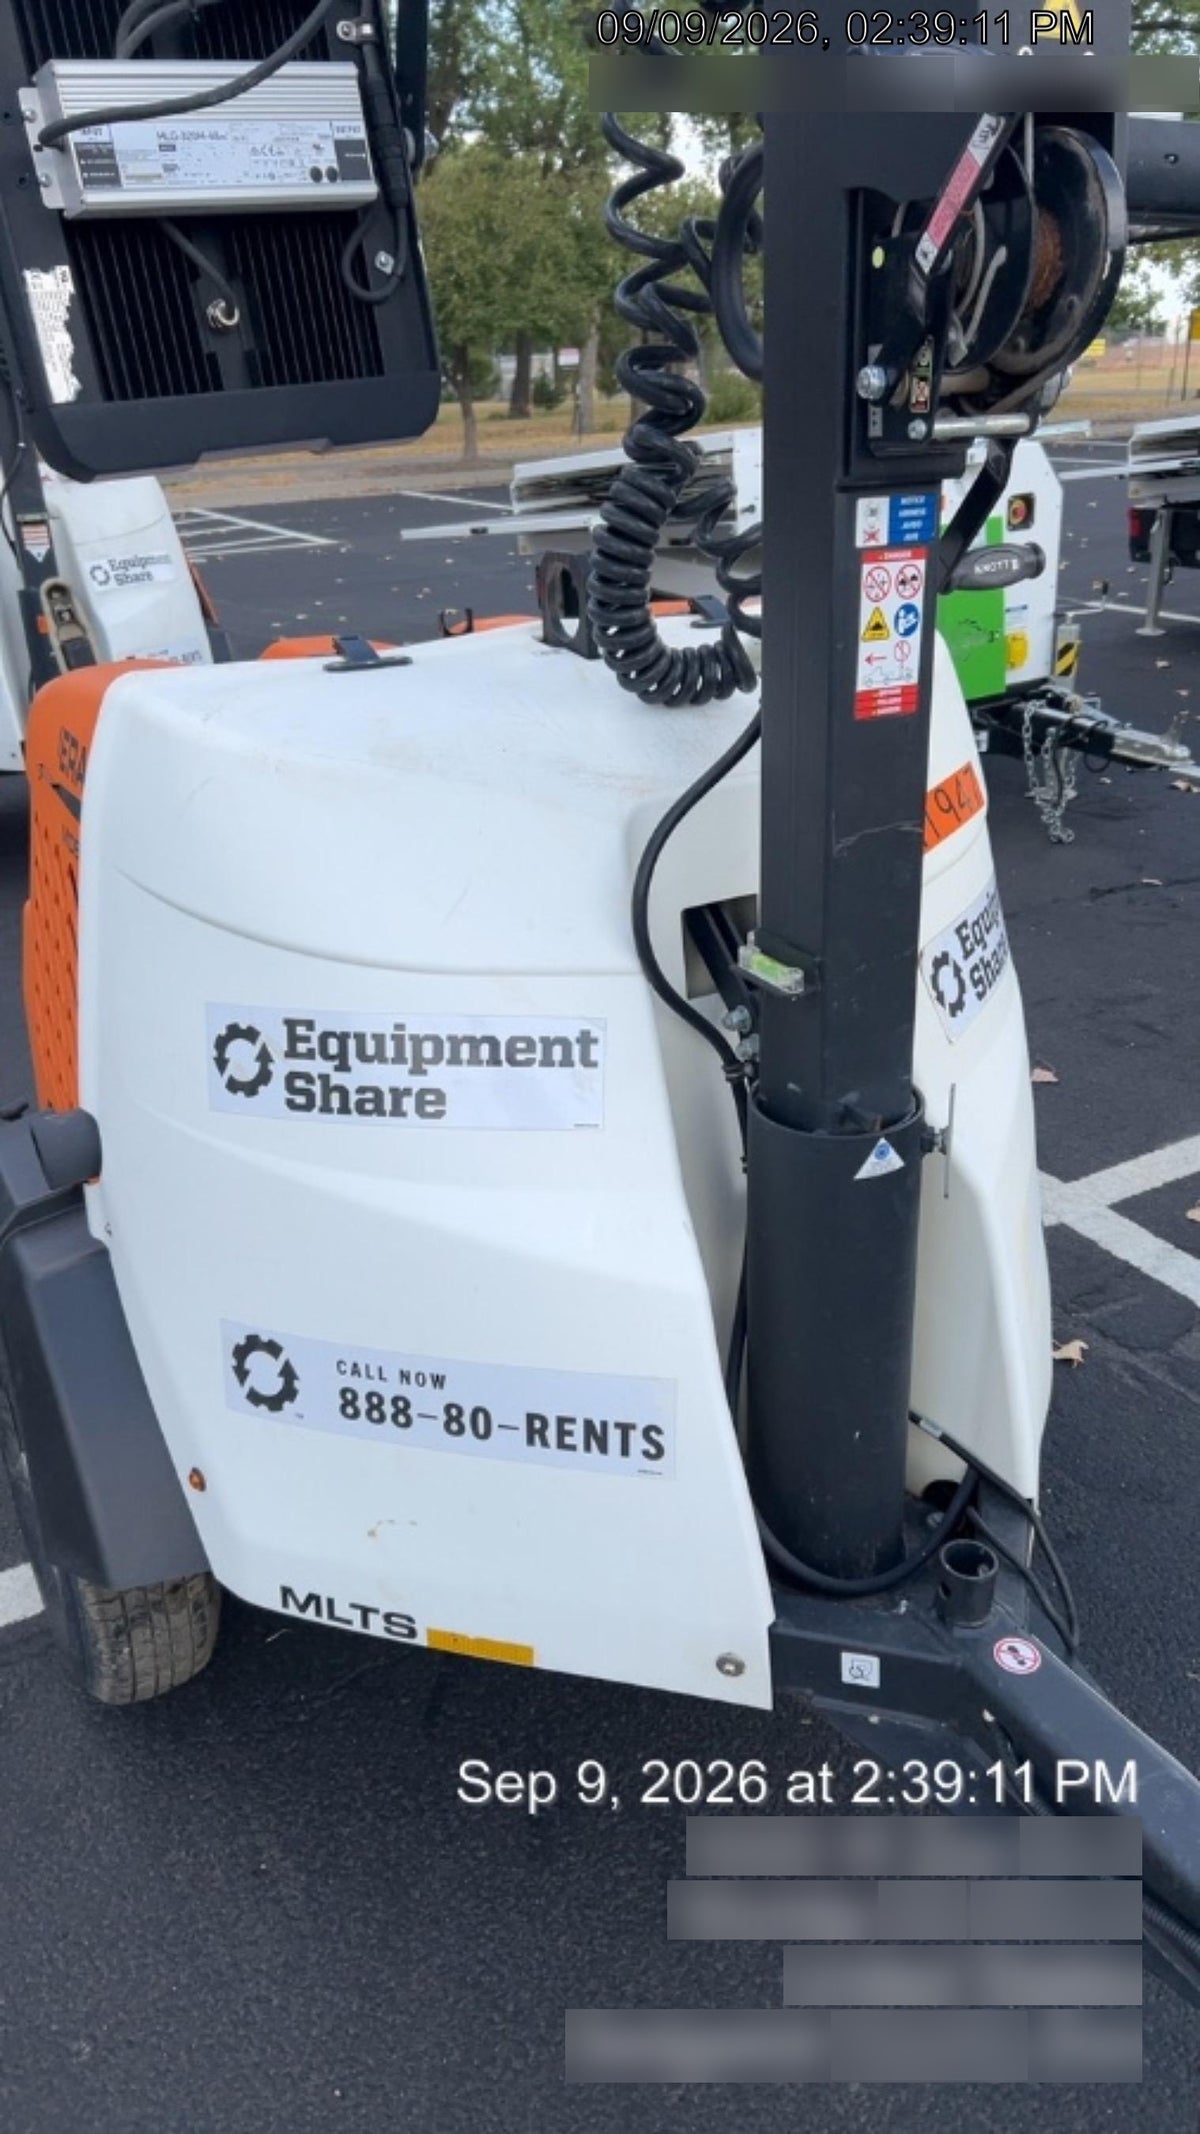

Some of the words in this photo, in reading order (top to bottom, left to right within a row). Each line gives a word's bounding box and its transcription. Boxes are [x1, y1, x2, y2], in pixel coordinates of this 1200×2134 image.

[282, 1017, 600, 1077] Equipment
[284, 1071, 447, 1120] Share
[336, 1359, 388, 1382] CALL
[399, 1369, 448, 1390] NOW
[338, 1386, 666, 1462] 888-80-RENTS
[279, 1584, 418, 1640] MLTS
